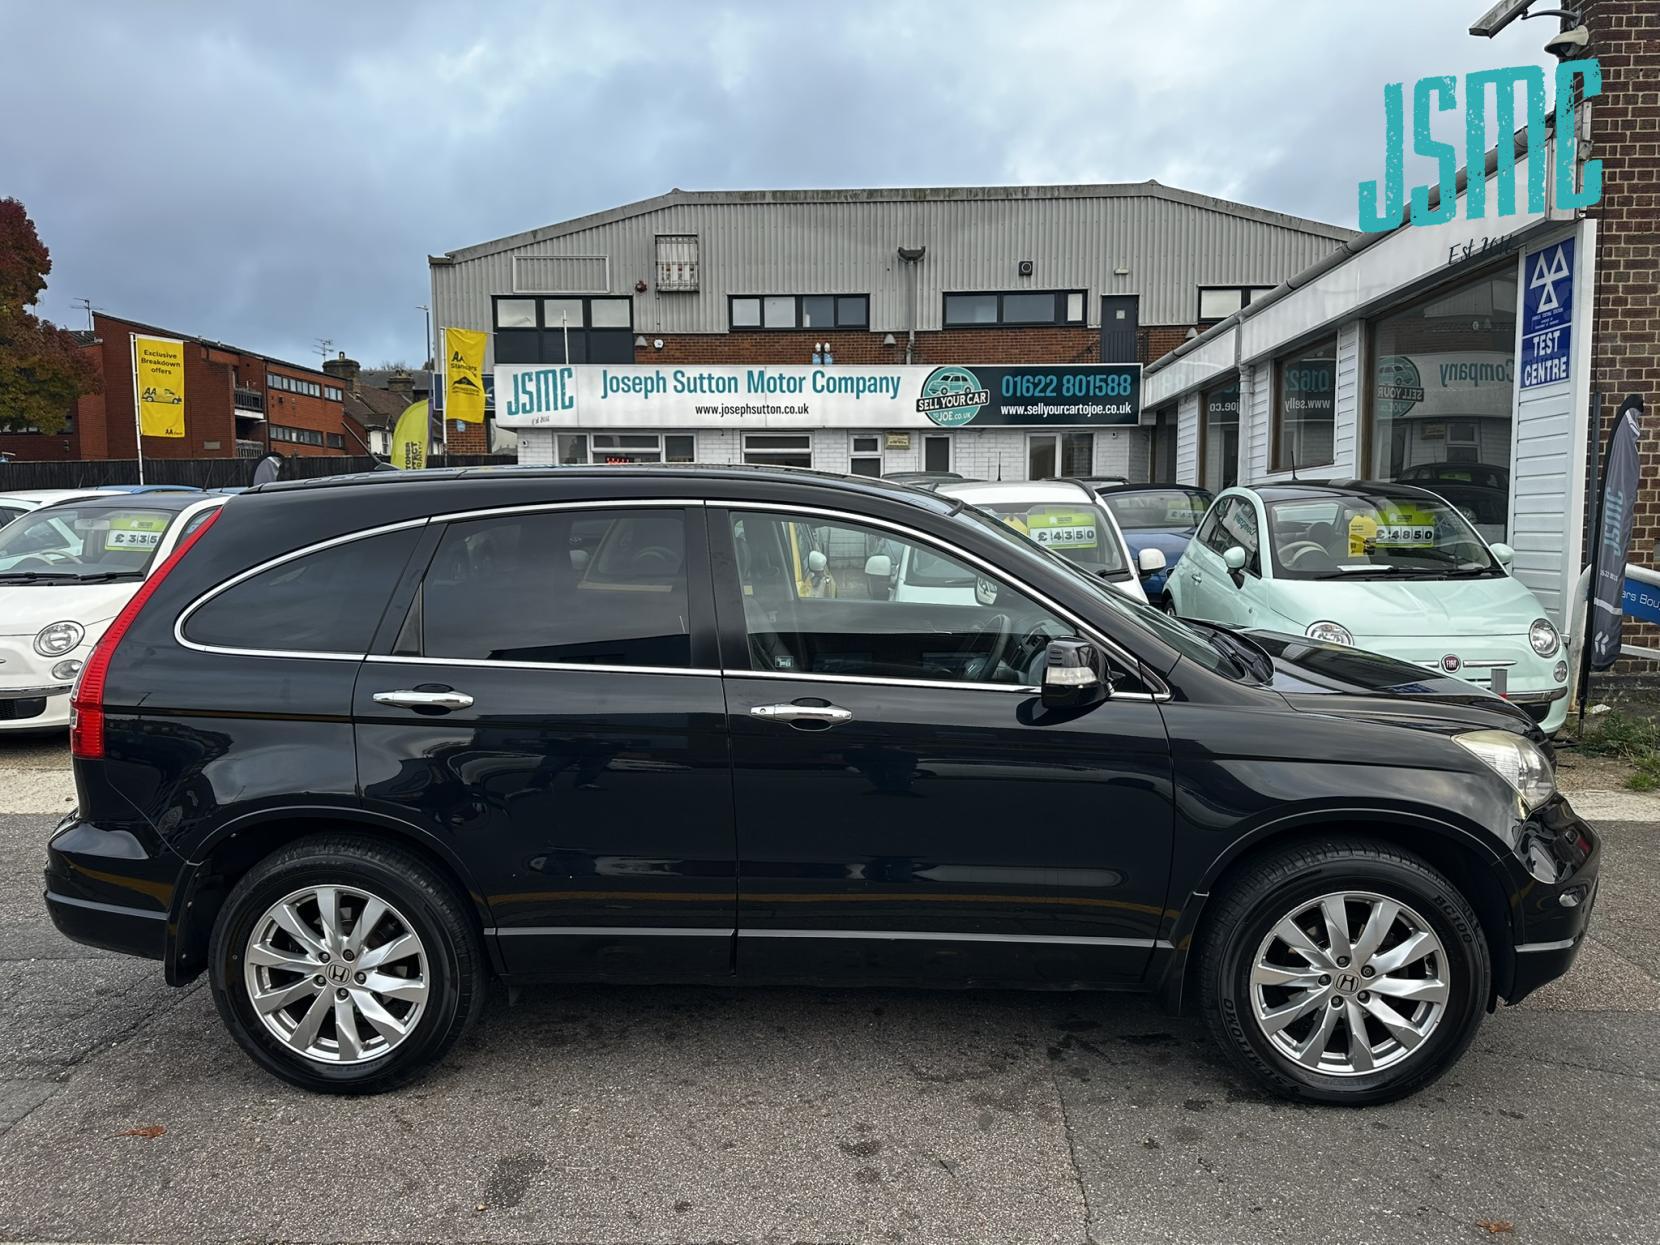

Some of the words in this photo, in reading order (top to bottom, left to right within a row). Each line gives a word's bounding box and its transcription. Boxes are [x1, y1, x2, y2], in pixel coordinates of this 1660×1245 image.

[1533, 330, 1560, 357] TEST
[141, 357, 181, 368] Breakdown
[144, 350, 177, 359] Exclusive
[1524, 355, 1567, 386] CENTRE
[144, 387, 157, 395] AA
[507, 367, 574, 416] JSMC
[601, 369, 667, 399] Joseph
[673, 369, 738, 393] Sutton
[747, 370, 806, 394] Motor
[812, 369, 901, 400] Company
[1001, 375, 1057, 397] 01622
[1062, 374, 1131, 397] 801588
[695, 403, 809, 418] www.josephsutton.co.uk
[918, 399, 940, 411] SELL
[940, 394, 966, 408] YOUR
[966, 392, 987, 404] CAR
[1000, 402, 1132, 418] www.sellyourcartojoe.co.uk
[1603, 486, 1624, 558] JSMC
[1037, 530, 1095, 542] £4350
[1640, 593, 1660, 611] Bou
[1445, 660, 1457, 668] FIAT
